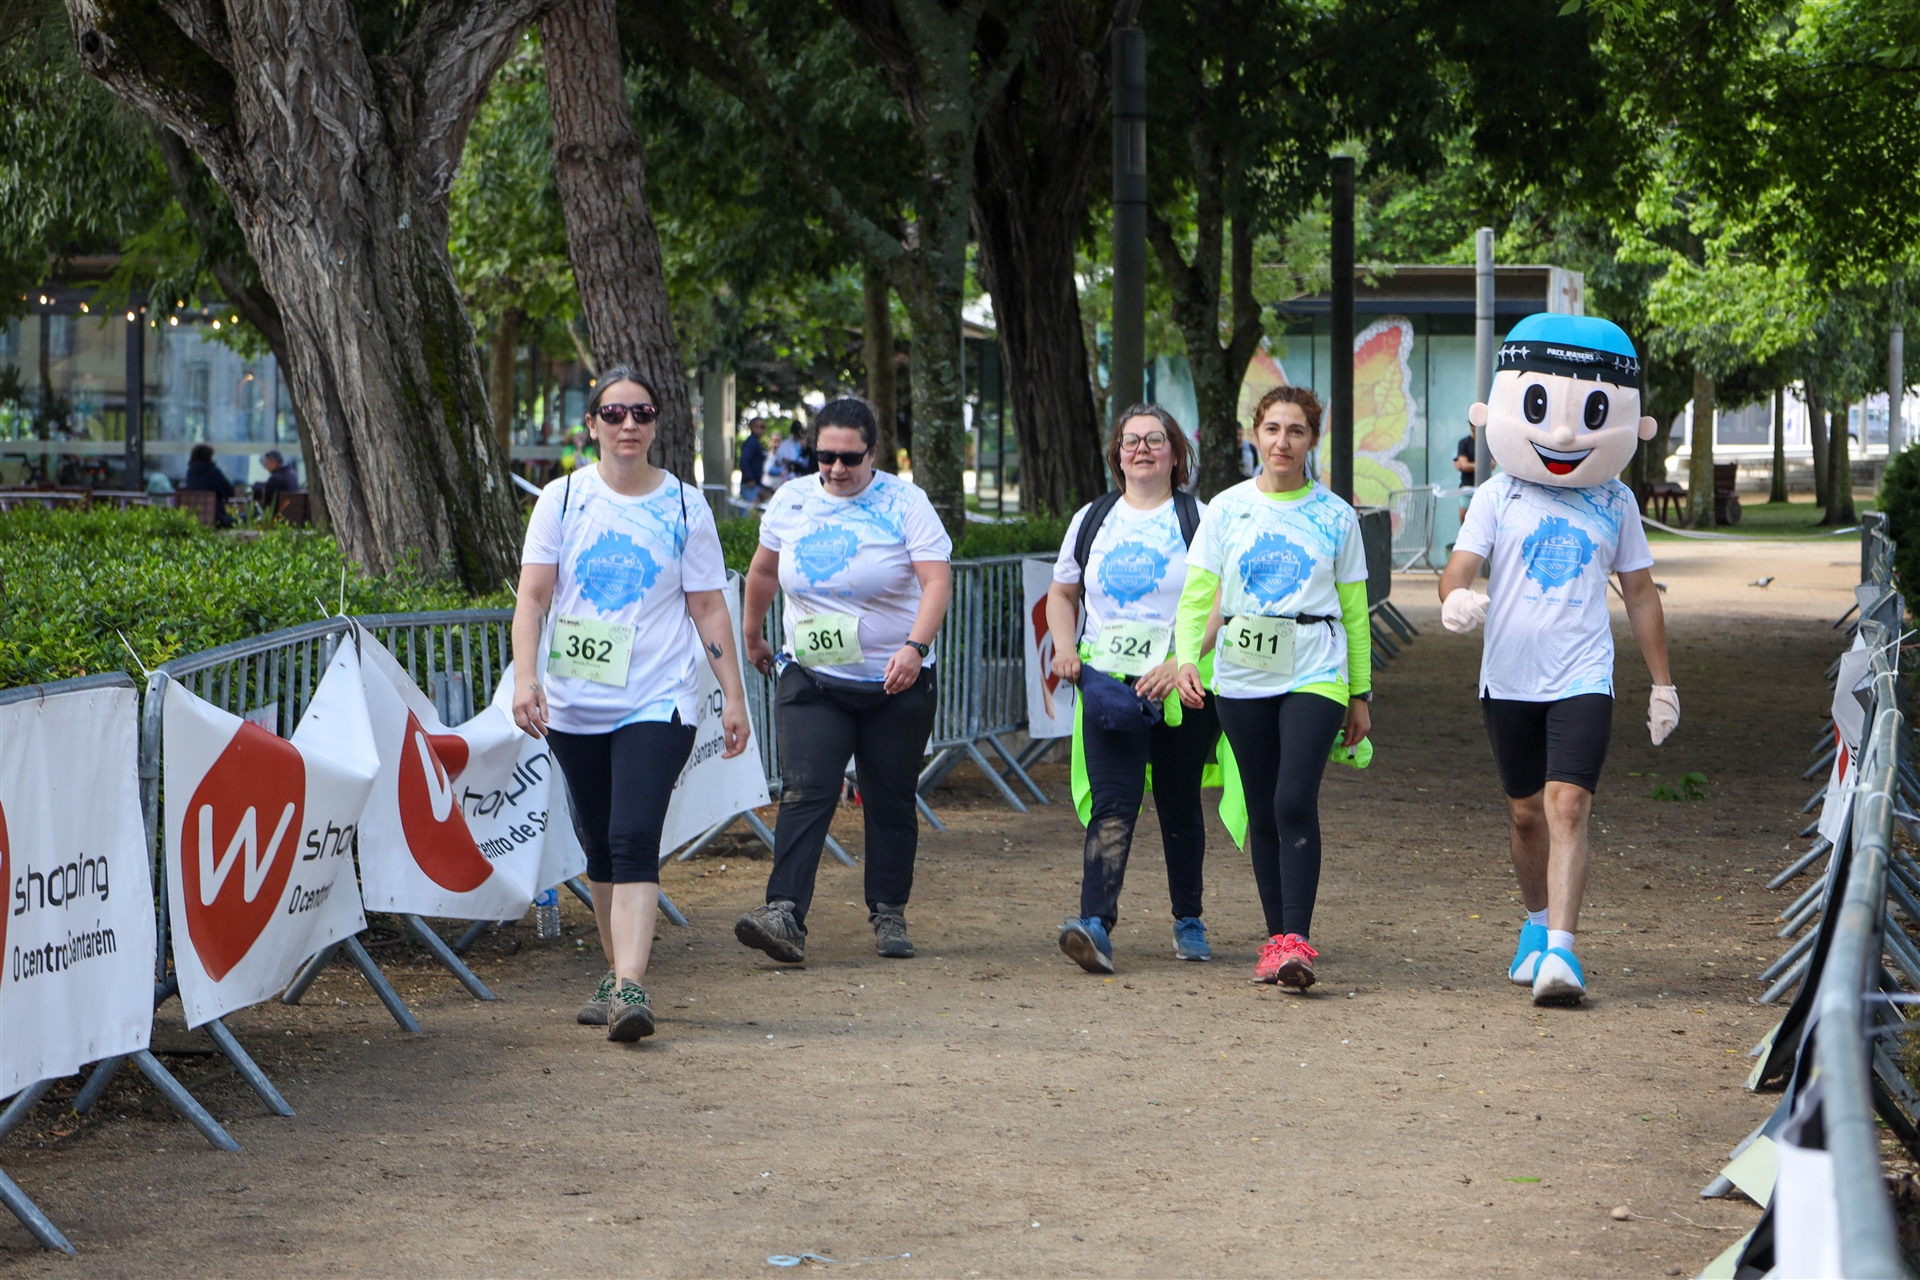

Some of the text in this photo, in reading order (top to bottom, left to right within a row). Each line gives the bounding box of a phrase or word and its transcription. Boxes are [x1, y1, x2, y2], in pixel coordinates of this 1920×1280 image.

[566, 634, 613, 663] 362
[808, 629, 844, 651] 361
[1109, 636, 1152, 659] 524
[1238, 628, 1279, 655] 511
[508, 825, 536, 844] de
[198, 801, 296, 907] W
